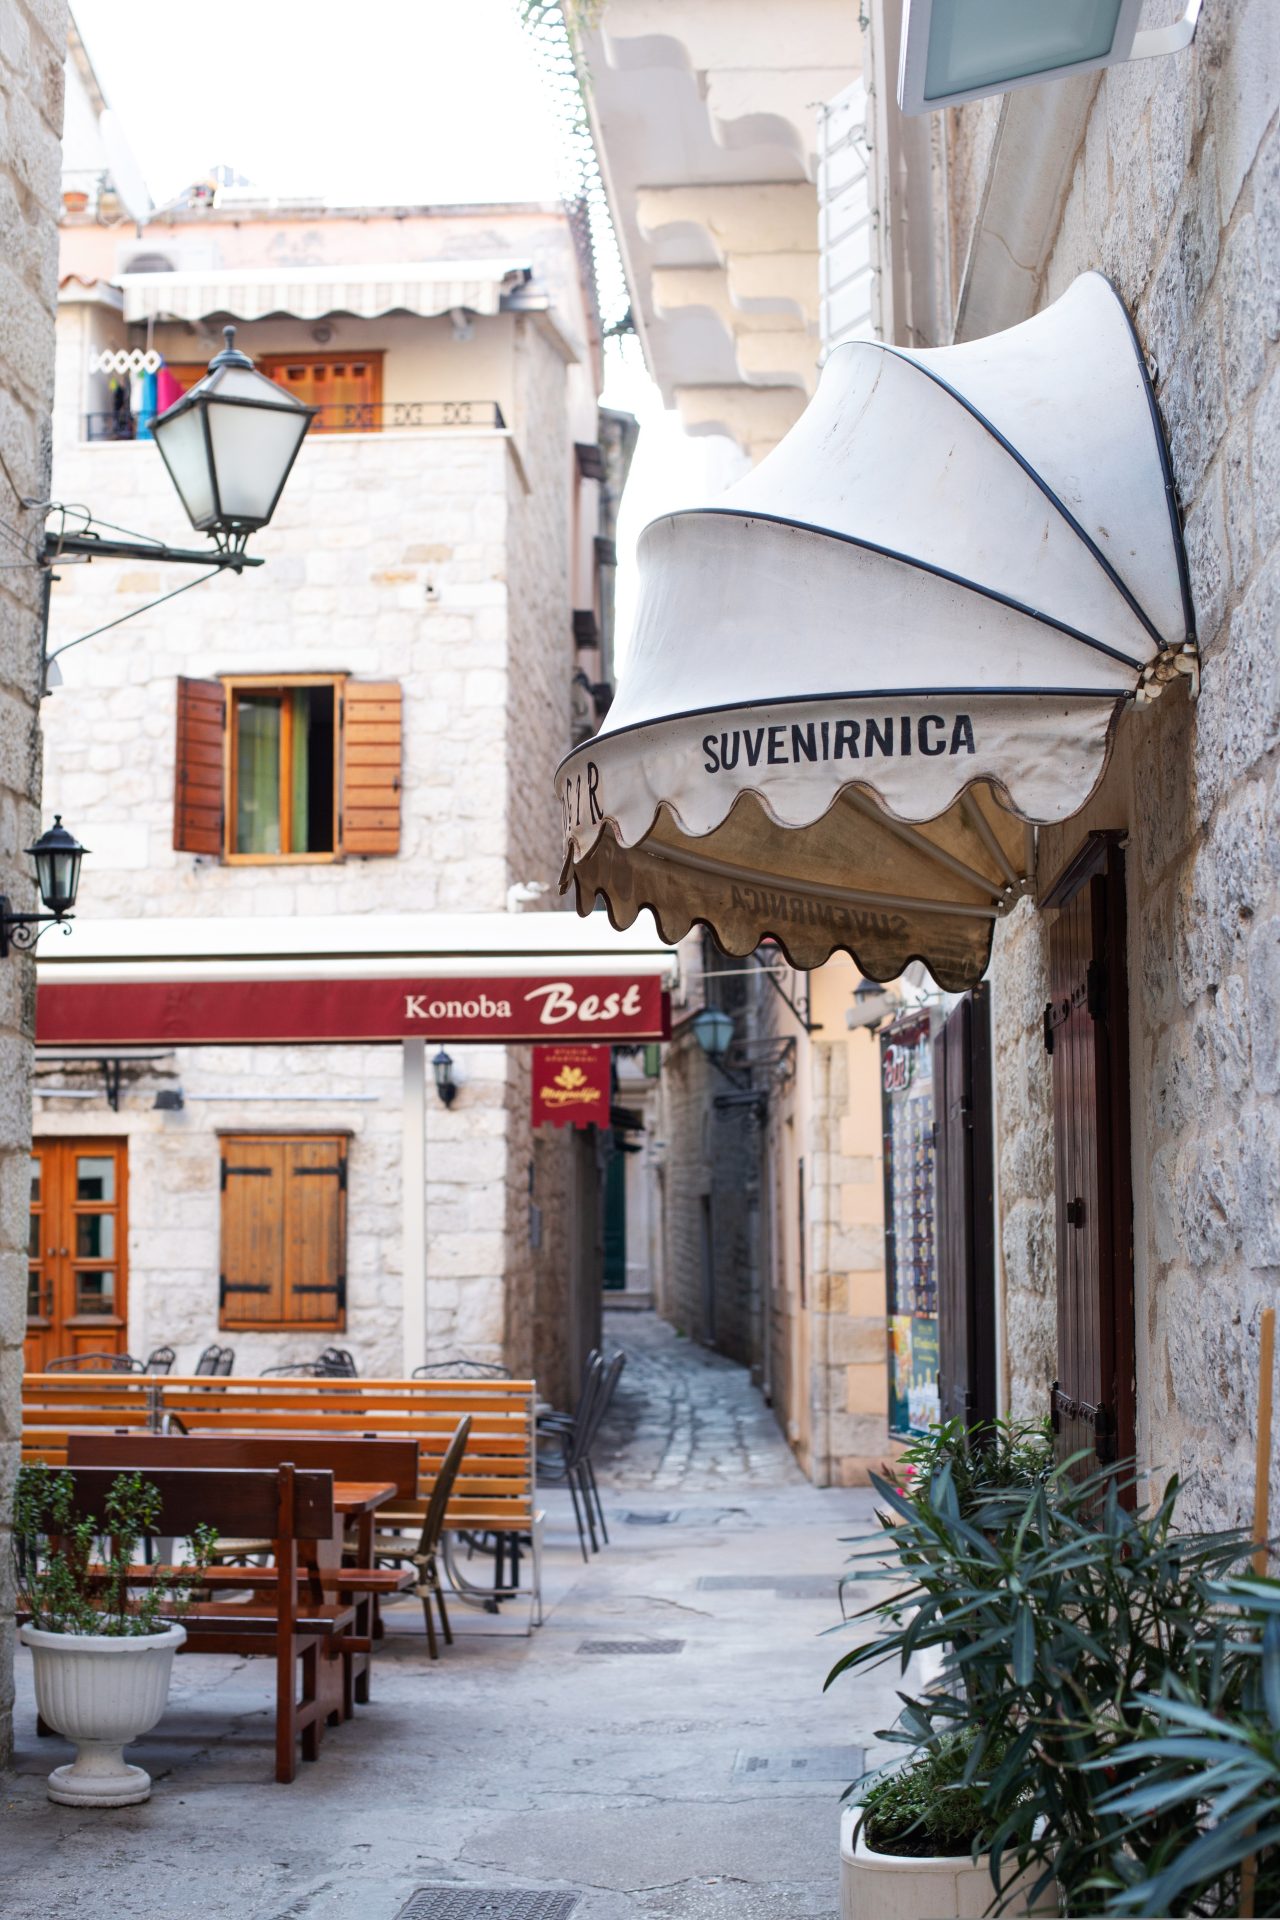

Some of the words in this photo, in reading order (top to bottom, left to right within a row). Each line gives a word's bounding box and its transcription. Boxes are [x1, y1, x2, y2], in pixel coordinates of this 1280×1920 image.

[702, 714, 975, 774] SUVENIRNICA
[404, 994, 512, 1019] Konoba
[523, 982, 642, 1025] Best
